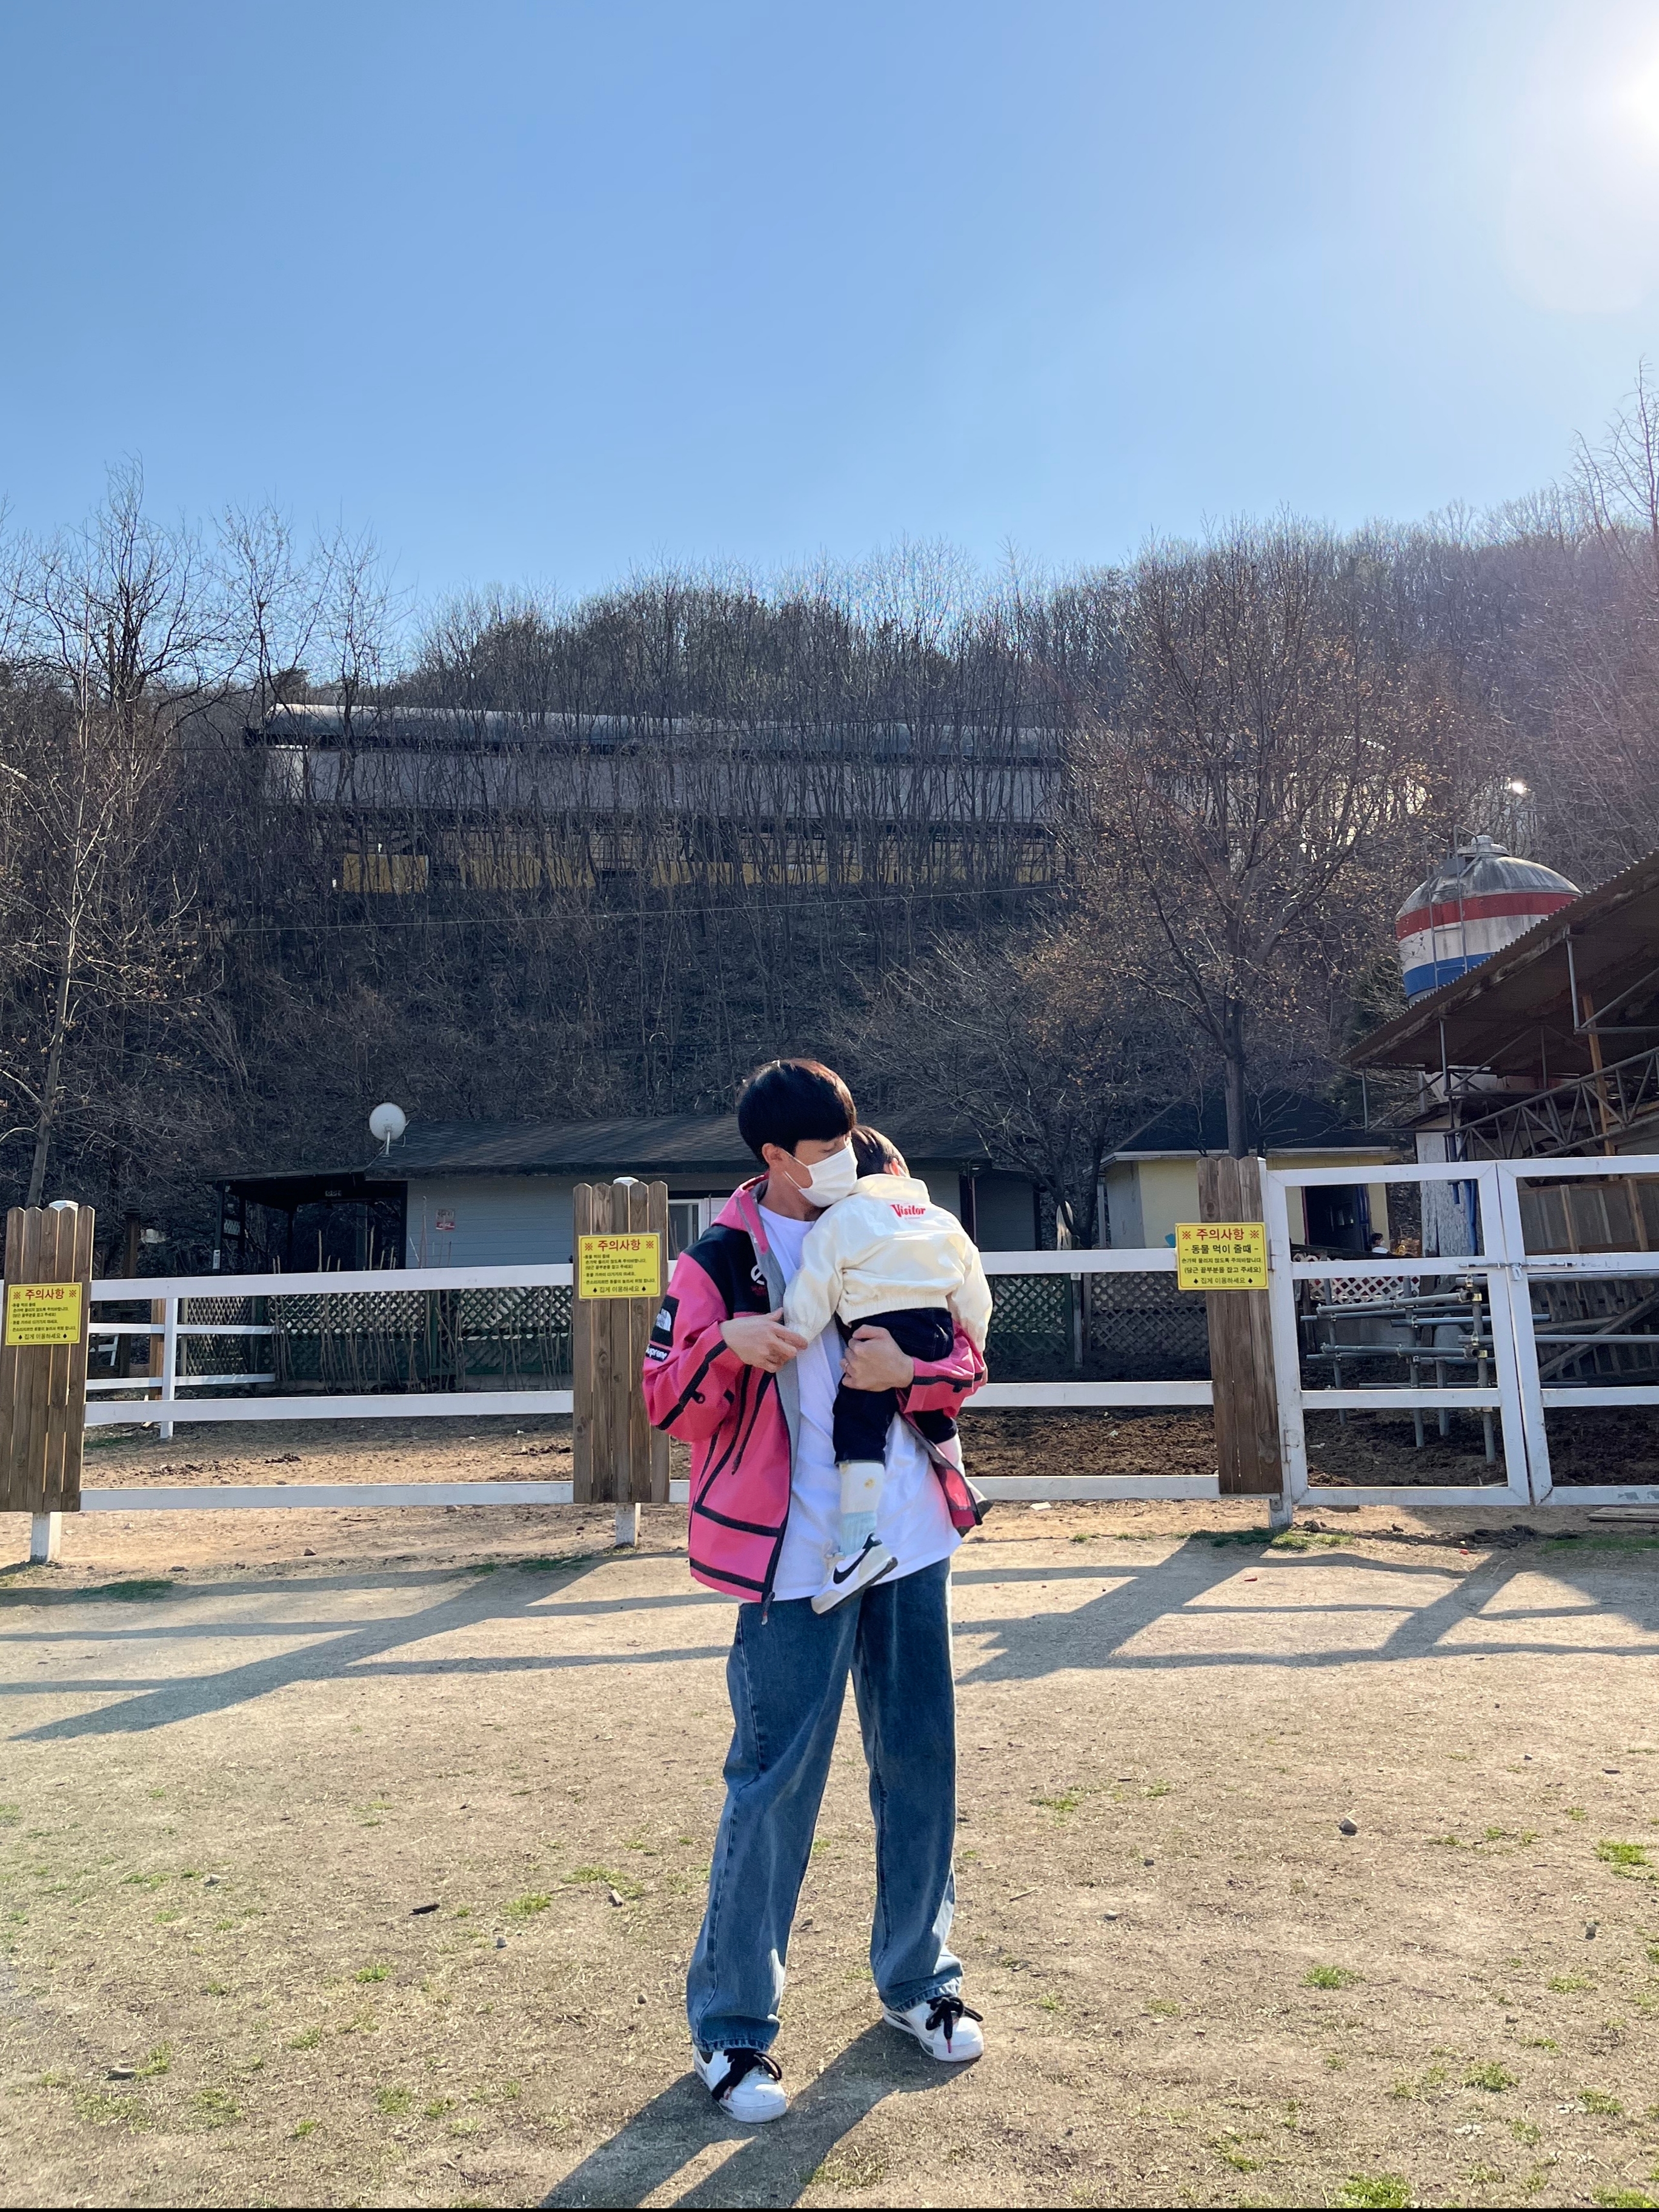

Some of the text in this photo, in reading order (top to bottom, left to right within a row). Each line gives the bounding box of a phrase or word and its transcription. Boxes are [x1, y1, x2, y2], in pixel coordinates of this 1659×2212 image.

[889, 1204, 926, 1218] Visitor
[1196, 1228, 1244, 1241] 주의사항
[598, 1239, 640, 1251] 주의사항
[1192, 1244, 1251, 1254] 동물 먹이 줄때
[25, 1288, 64, 1300] 주의사항
